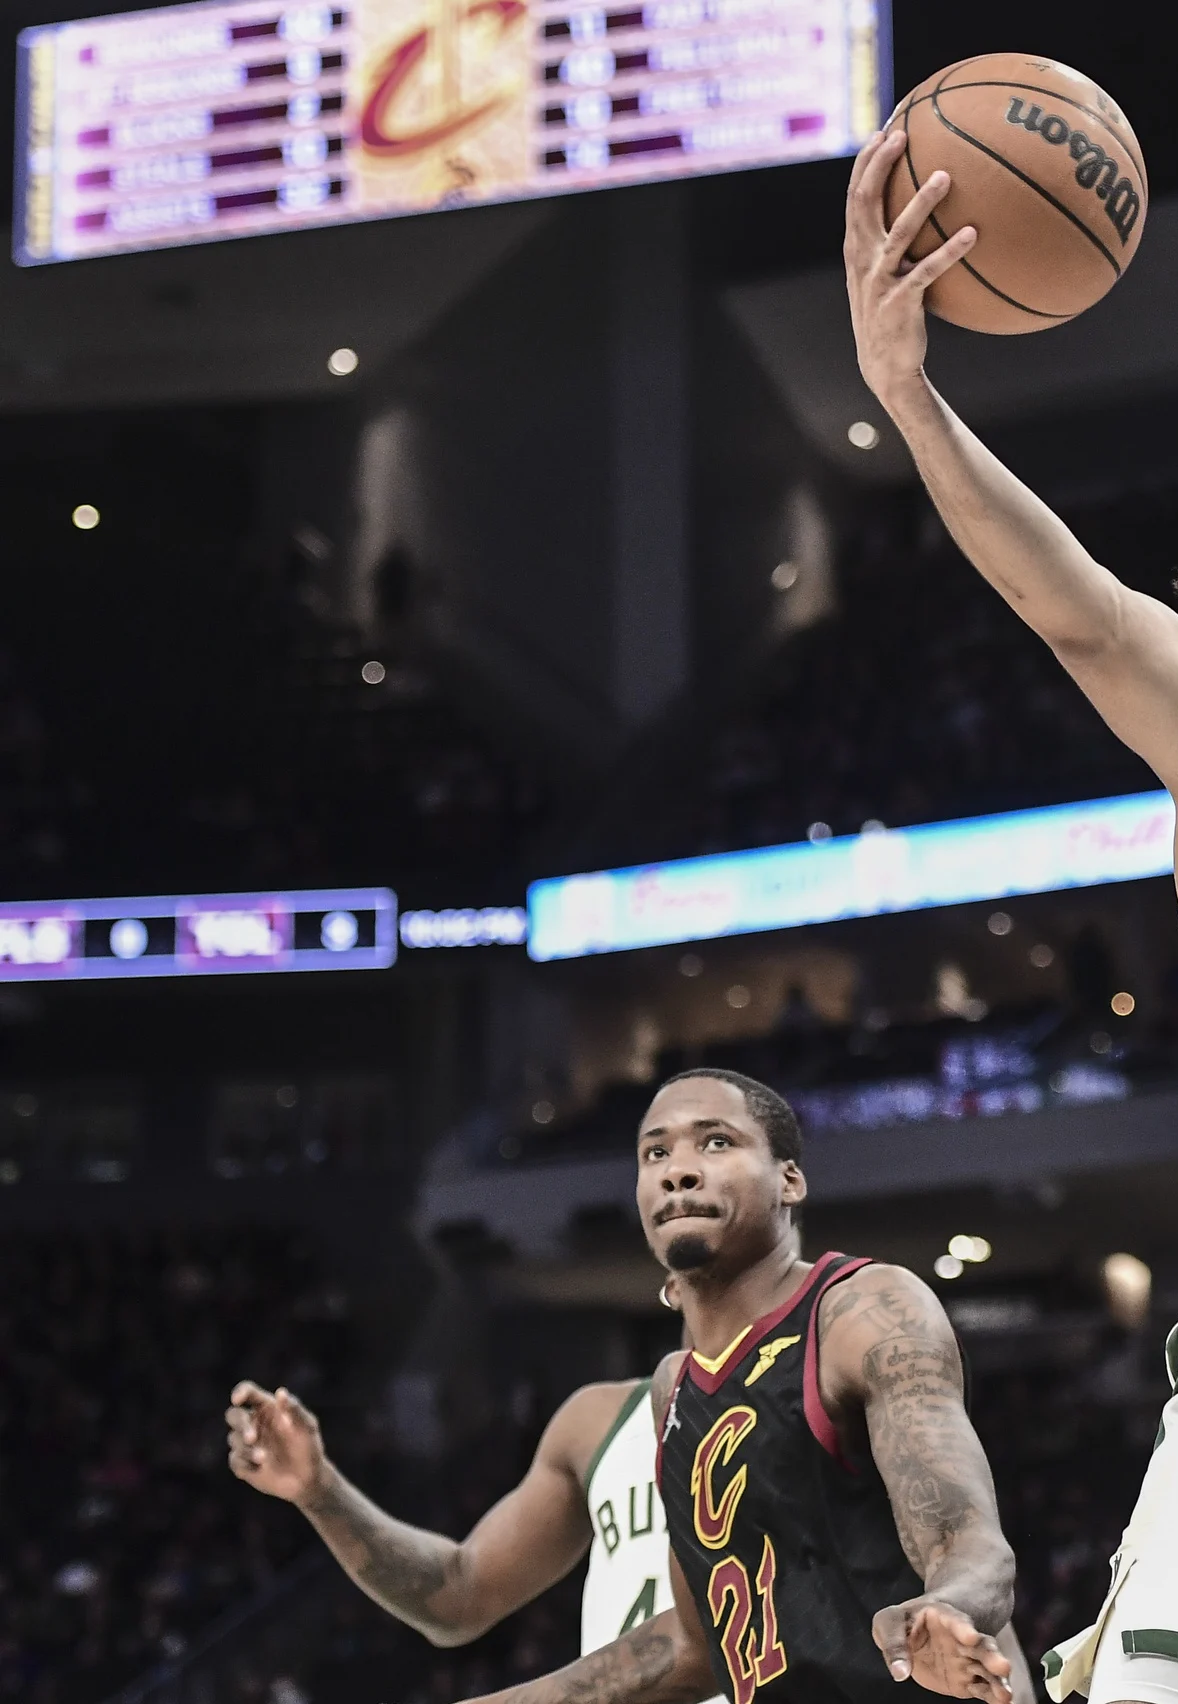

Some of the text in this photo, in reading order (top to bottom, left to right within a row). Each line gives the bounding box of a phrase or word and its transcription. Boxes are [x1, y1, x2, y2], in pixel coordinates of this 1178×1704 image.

[1005, 96, 1140, 247] Wilson
[597, 1481, 669, 1557] BU
[691, 1405, 757, 1549] C
[707, 1533, 788, 1704] 21
